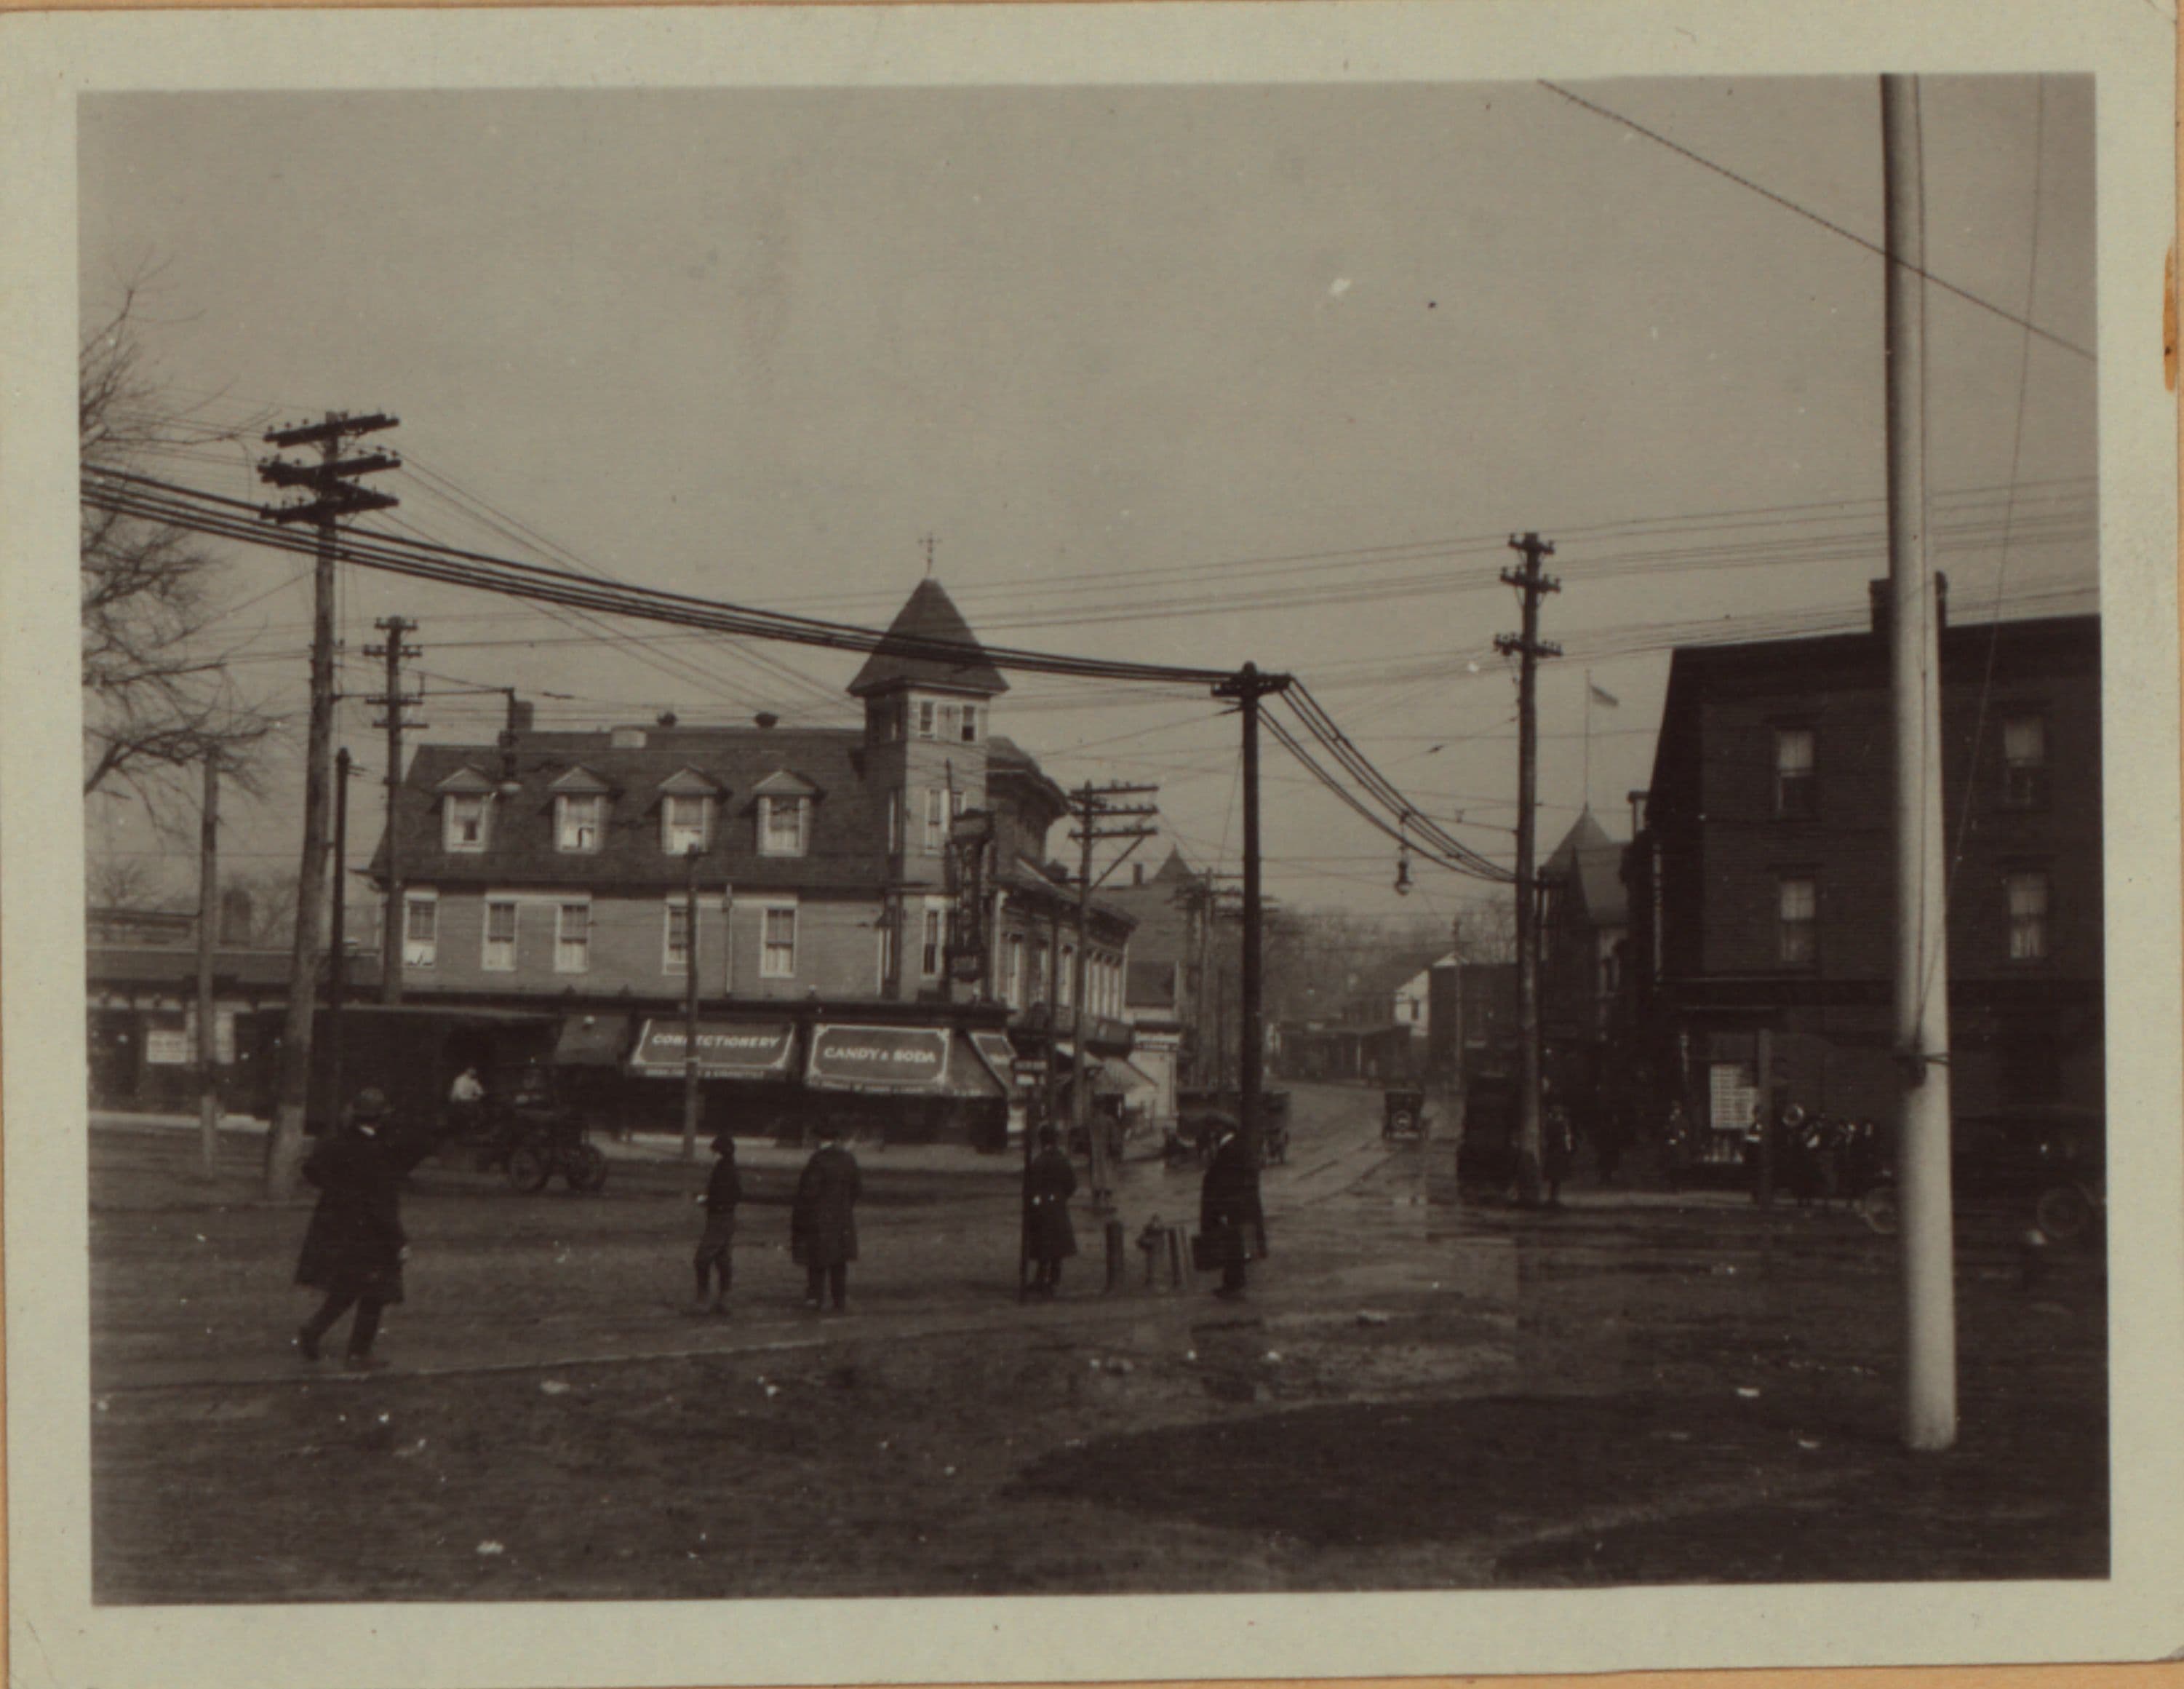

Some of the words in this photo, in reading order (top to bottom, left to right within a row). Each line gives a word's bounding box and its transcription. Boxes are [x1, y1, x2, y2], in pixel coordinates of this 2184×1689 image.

[652, 1034, 781, 1048] CONECTIONERY
[824, 1046, 880, 1060] CANDY
[893, 1049, 936, 1063] SODA
